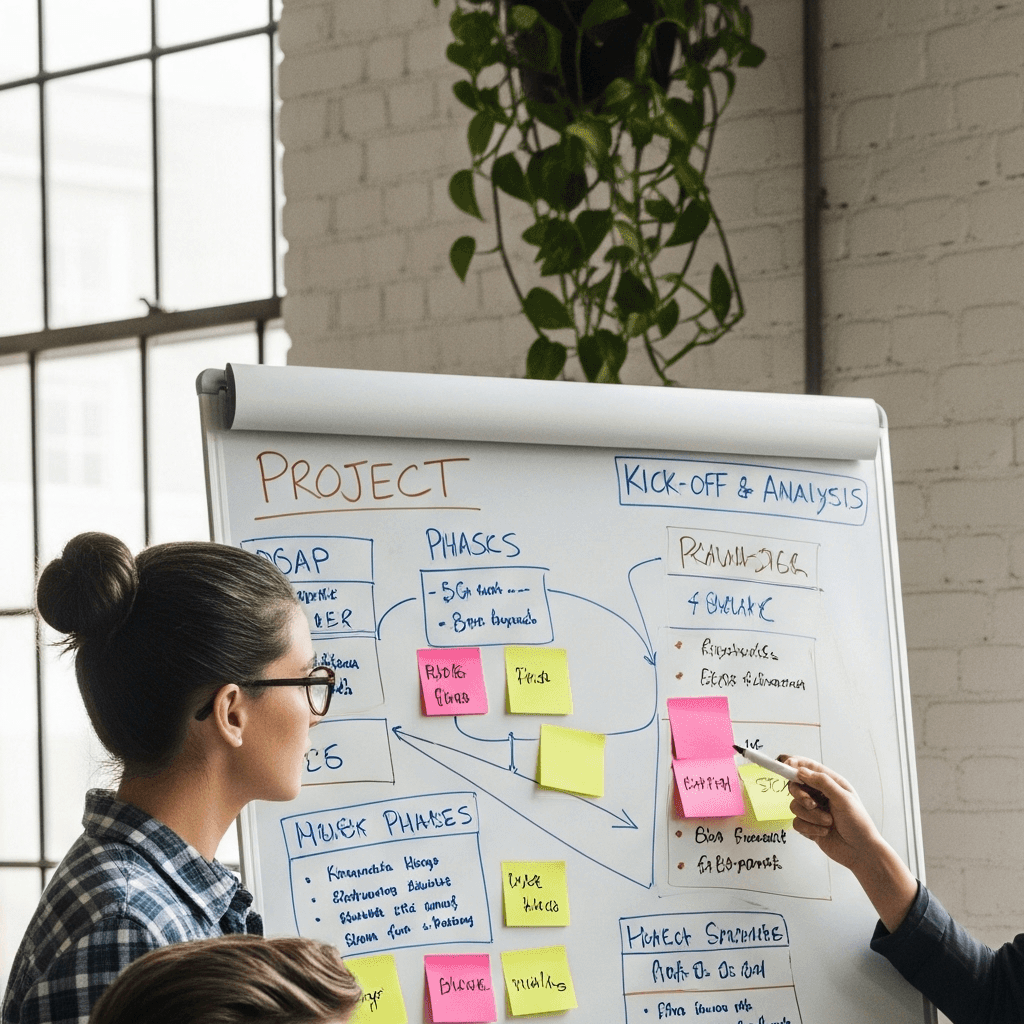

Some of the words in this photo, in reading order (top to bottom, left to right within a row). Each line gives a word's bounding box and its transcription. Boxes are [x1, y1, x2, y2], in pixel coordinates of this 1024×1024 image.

[256, 451, 470, 503] PROJECT
[624, 464, 728, 498] KICK-OFF
[737, 476, 754, 498] &
